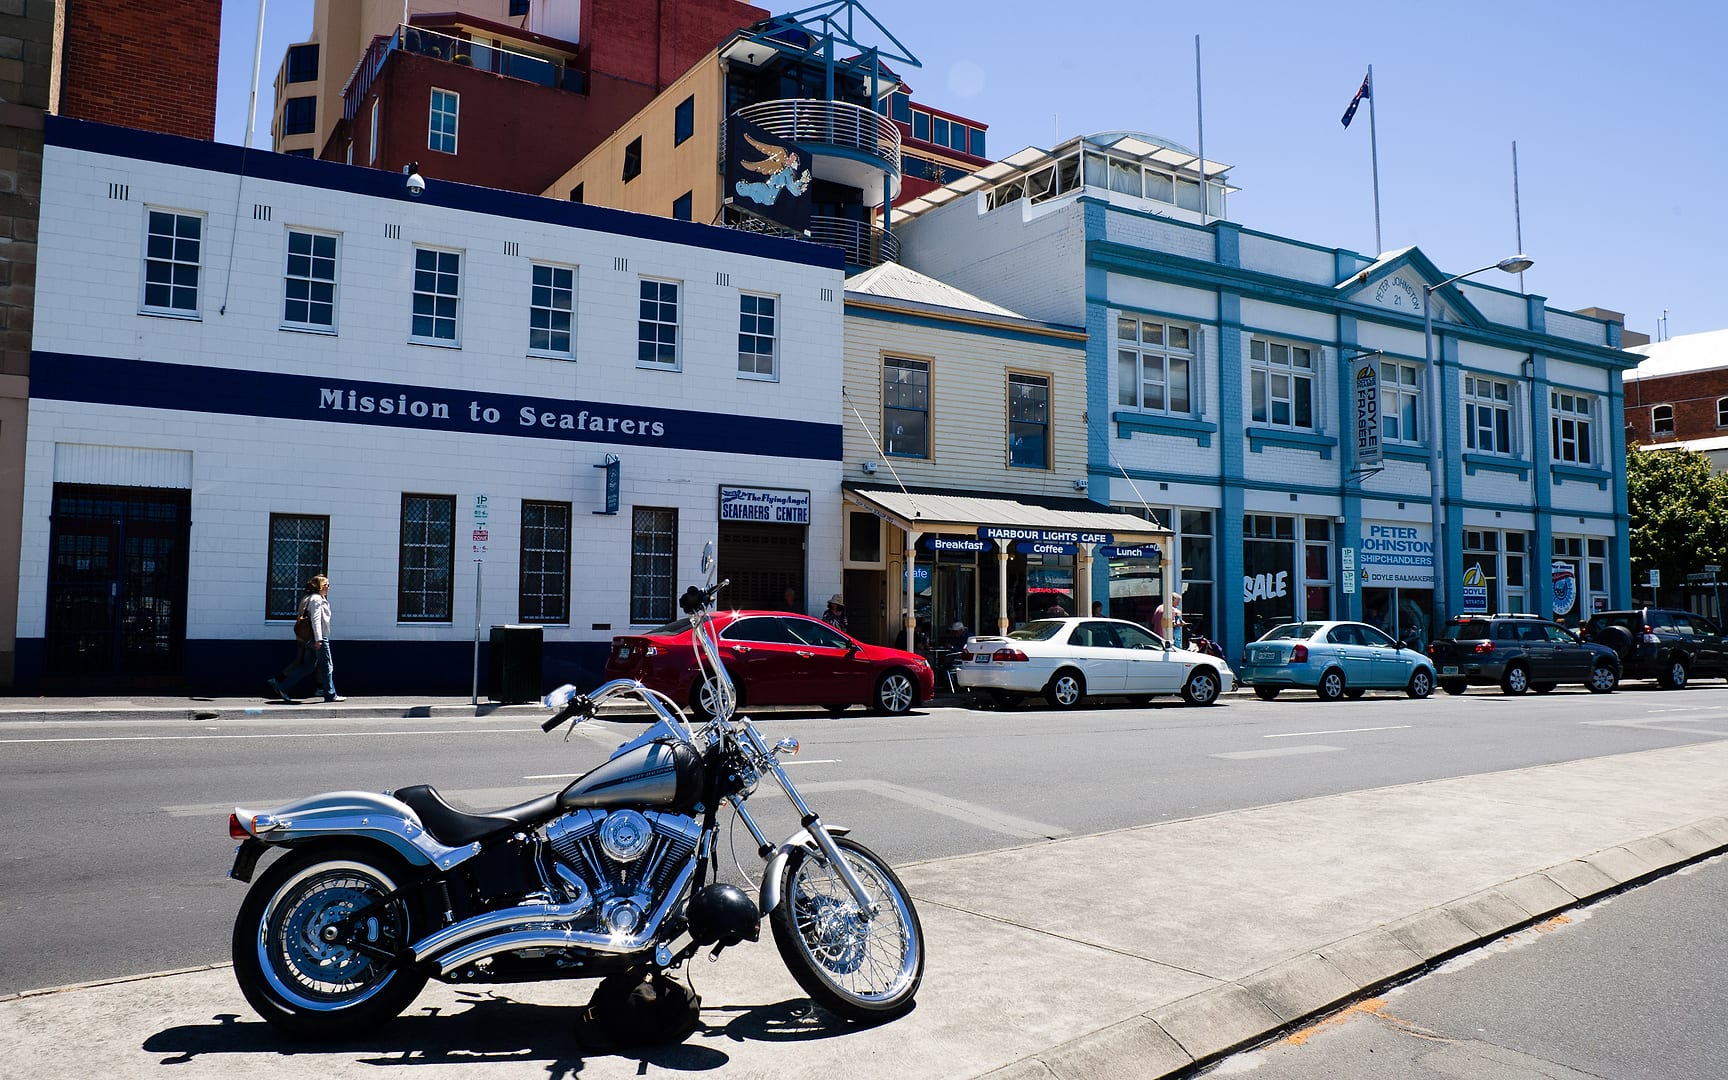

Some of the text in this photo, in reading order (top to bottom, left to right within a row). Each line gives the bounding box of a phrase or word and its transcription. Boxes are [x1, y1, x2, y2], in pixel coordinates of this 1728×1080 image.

[1375, 276, 1421, 310] PETER JOHNSTON
[1394, 294, 1402, 306] 21
[319, 388, 666, 437] Mission to Seafarers
[1357, 389, 1366, 448] FRASER
[1367, 387, 1377, 447] DOYLE
[477, 495, 487, 504] 1P
[746, 492, 809, 505] The Flying Angel
[722, 503, 808, 522] SEAFARERS' CENTRE
[987, 528, 1107, 543] HARBOUR LIGHTS CAFE
[1370, 525, 1418, 539] PETER
[935, 539, 984, 550] Breakfast
[1033, 544, 1064, 554] Coffee
[1116, 547, 1143, 557] Lunch
[1361, 554, 1432, 565] SHIPCHANDLERS
[1371, 573, 1435, 583] DOYLE SAILMAKERS
[1243, 570, 1288, 603] SALE
